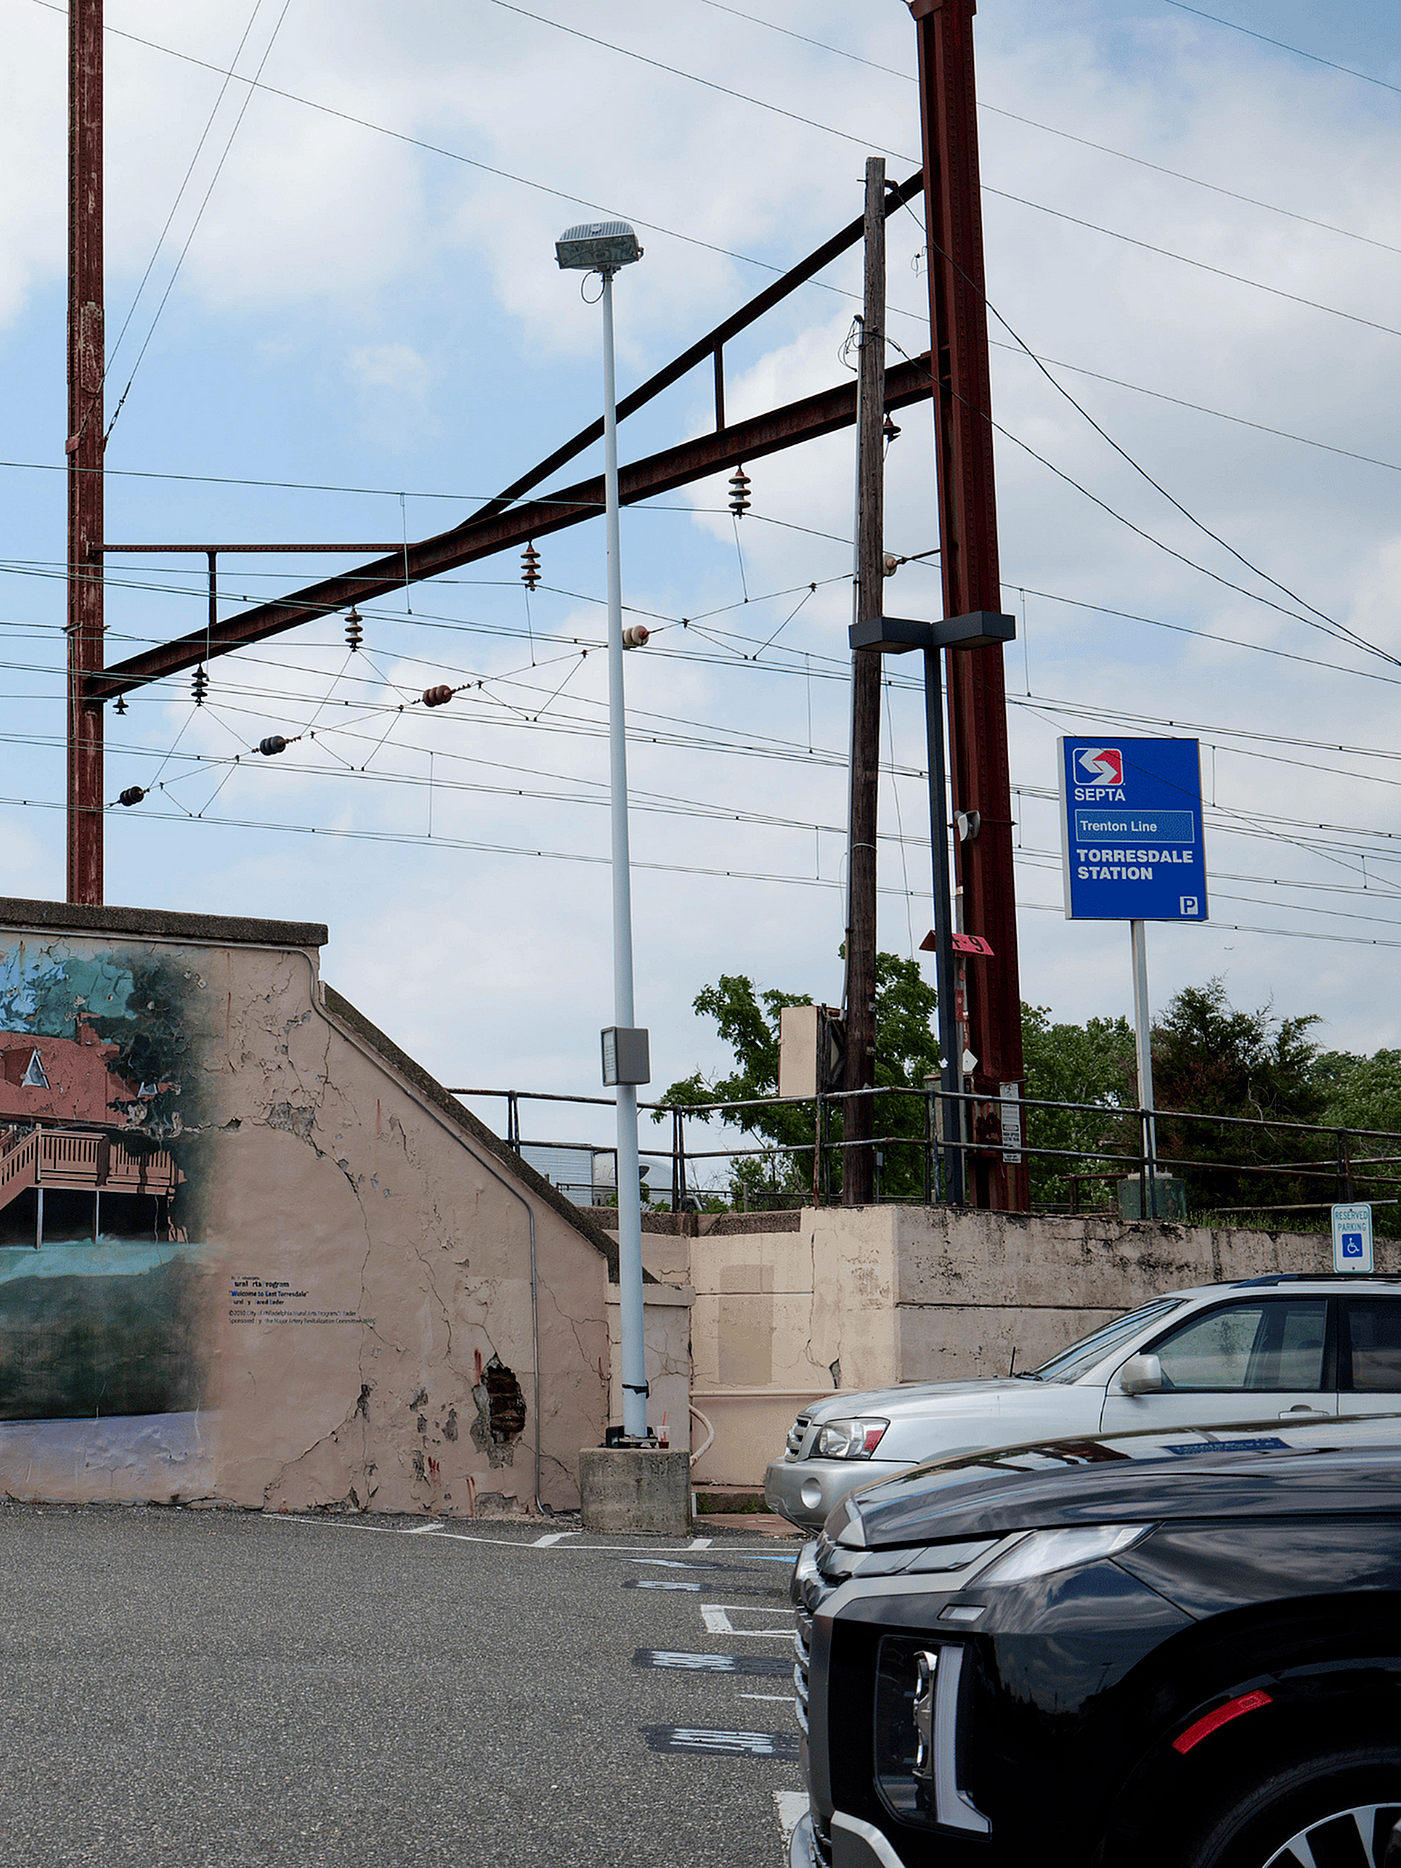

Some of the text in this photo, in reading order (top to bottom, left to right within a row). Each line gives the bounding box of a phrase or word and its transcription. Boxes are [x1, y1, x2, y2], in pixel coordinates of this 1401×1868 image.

[1074, 788, 1126, 802] SEPTA
[1080, 820, 1158, 832] Trenton Line
[1076, 849, 1194, 863] TORRESDALE
[1077, 866, 1153, 880] STATION
[1183, 899, 1196, 914] P
[1335, 1210, 1368, 1220] RESERVED
[1337, 1222, 1367, 1232] PARKING
